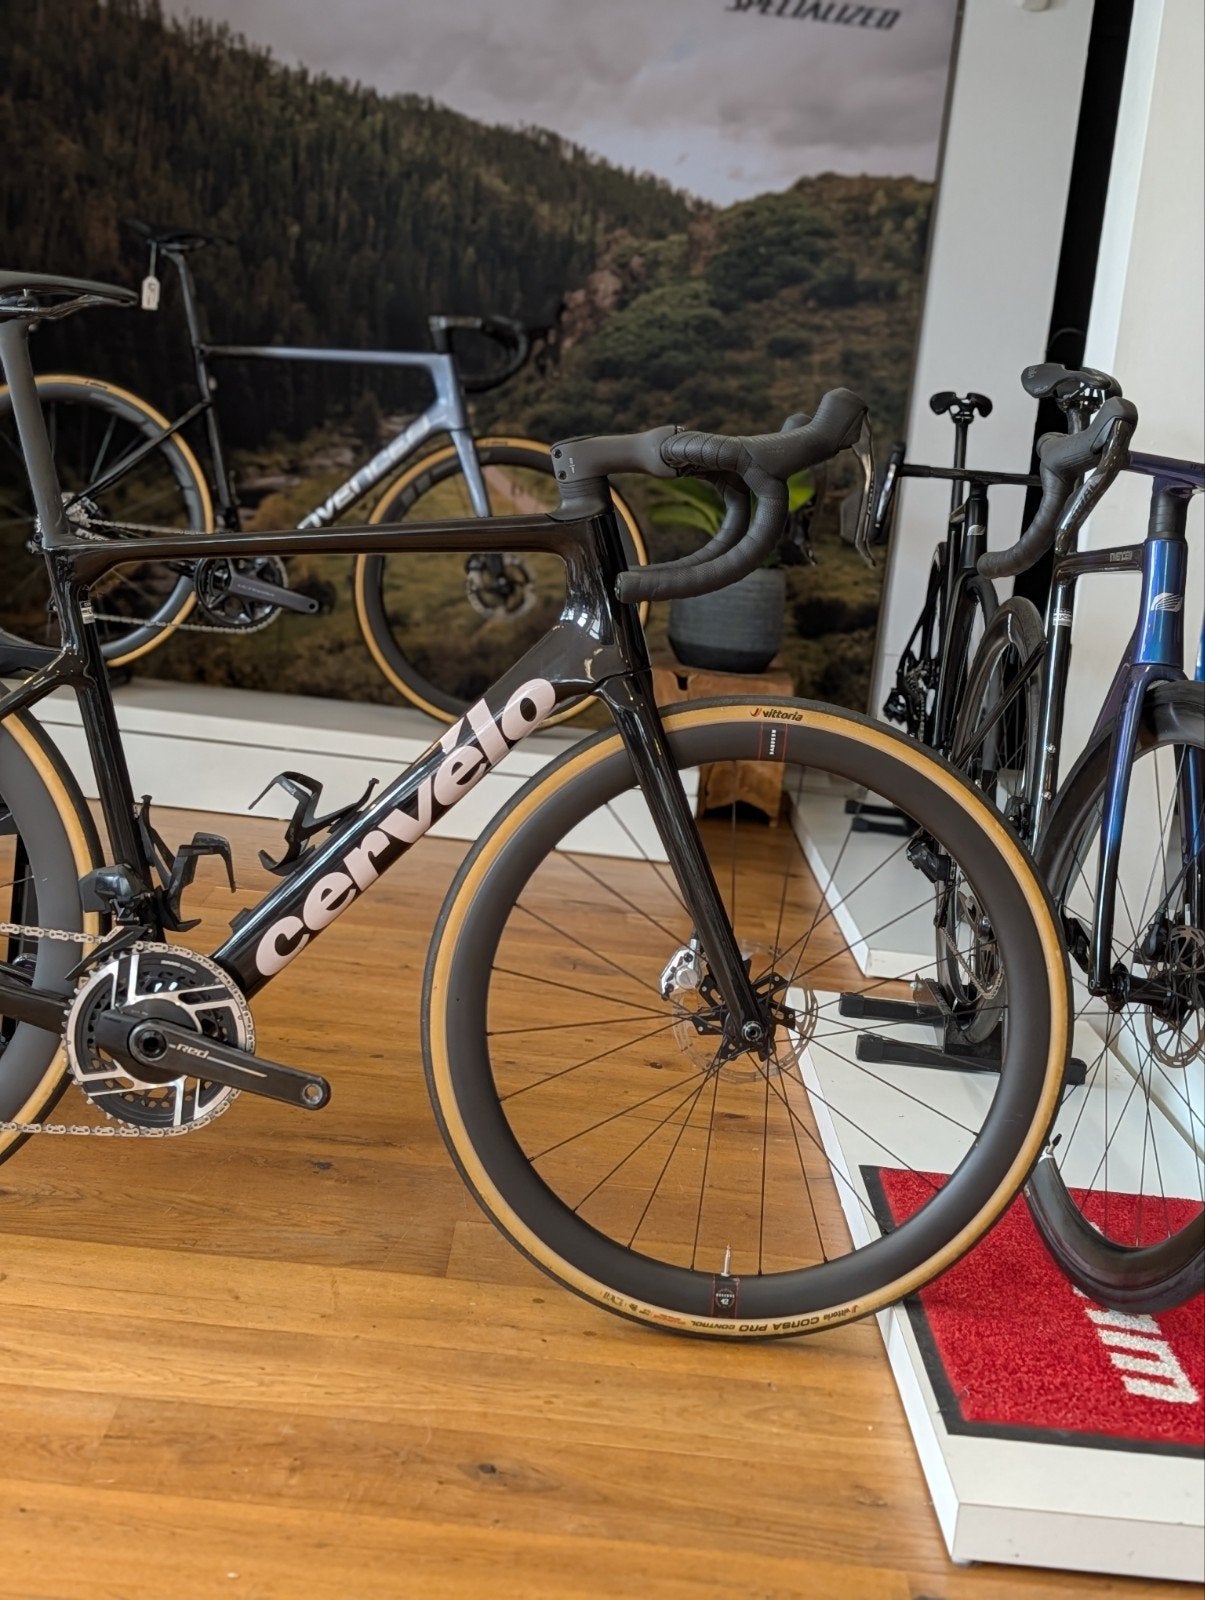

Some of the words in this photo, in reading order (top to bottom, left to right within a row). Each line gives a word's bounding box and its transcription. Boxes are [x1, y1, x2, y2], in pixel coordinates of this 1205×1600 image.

[763, 708, 803, 721] vittoria
[256, 678, 555, 976] cervélo
[823, 1307, 851, 1321] vittoria
[690, 1320, 736, 1330] CONTROL
[739, 1324, 768, 1332] PRO
[773, 1317, 820, 1331] CORSA
